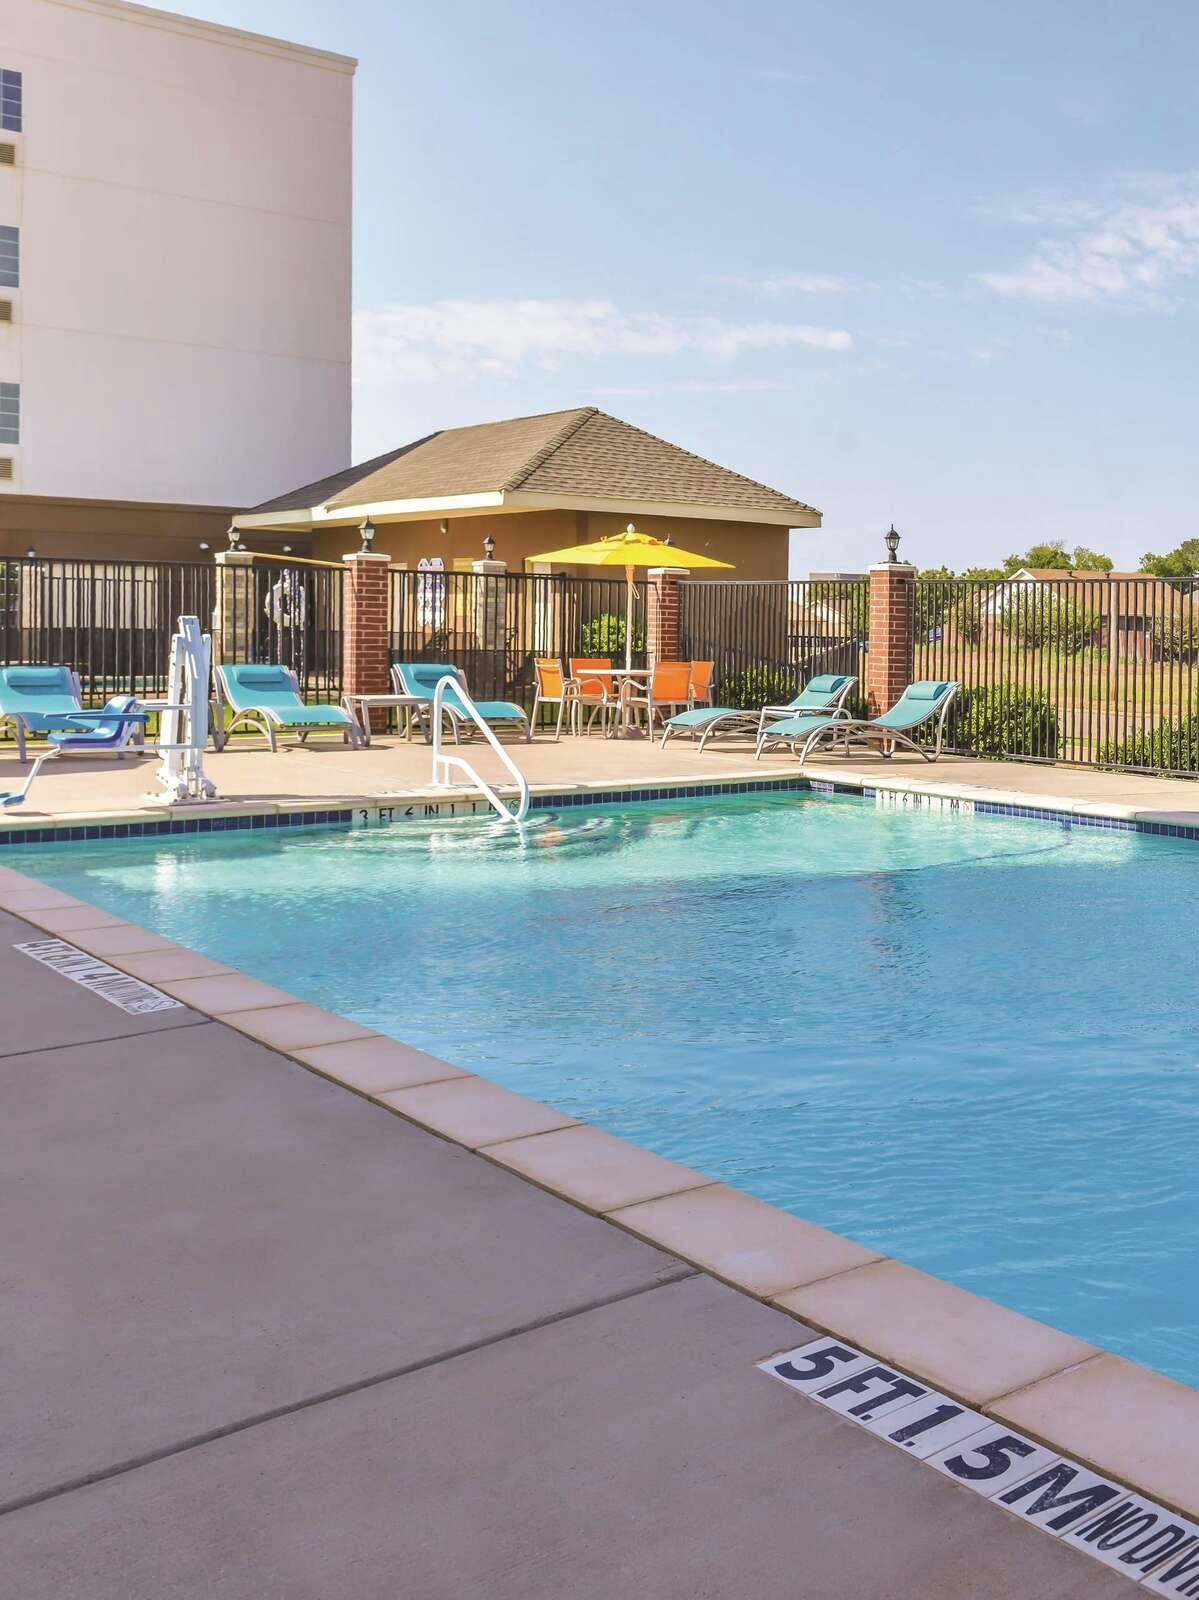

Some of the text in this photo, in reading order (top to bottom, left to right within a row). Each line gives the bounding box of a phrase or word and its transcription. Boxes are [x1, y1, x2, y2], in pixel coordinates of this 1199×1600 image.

[425, 804, 439, 816] IN
[773, 1345, 860, 1381] 5
[815, 1365, 929, 1422] FT.
[997, 1462, 1122, 1532] M
[1074, 1501, 1160, 1551] NO
